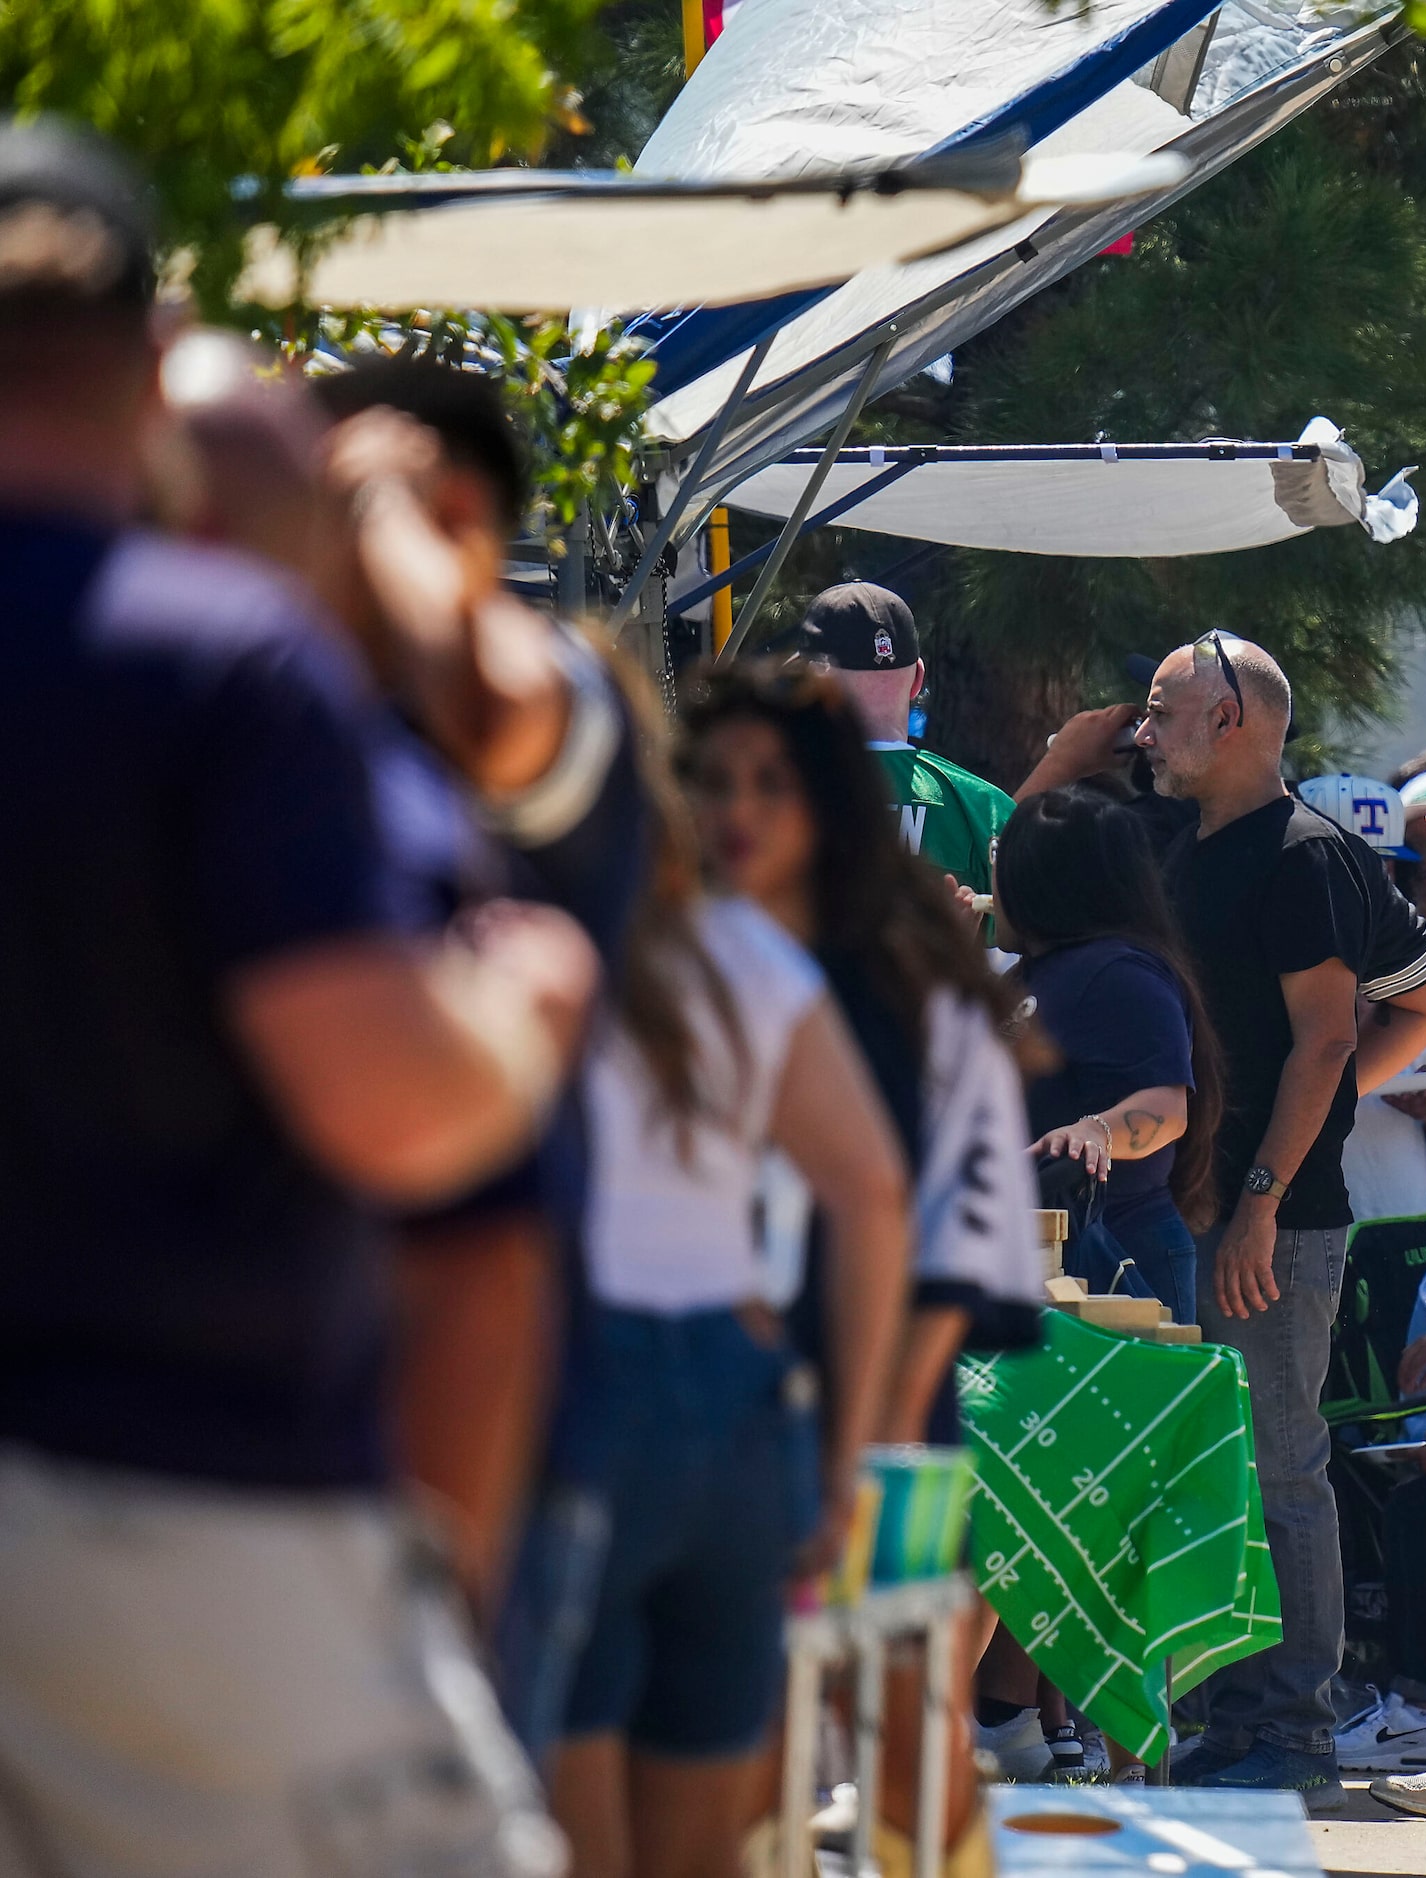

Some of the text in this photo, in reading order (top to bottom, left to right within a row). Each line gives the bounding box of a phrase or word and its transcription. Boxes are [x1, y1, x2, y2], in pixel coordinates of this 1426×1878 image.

[1353, 798, 1388, 835] T
[1019, 1411, 1057, 1447] 30
[1072, 1468, 1109, 1507] 20
[986, 1551, 1020, 1591] 20
[1031, 1612, 1060, 1648] 10
